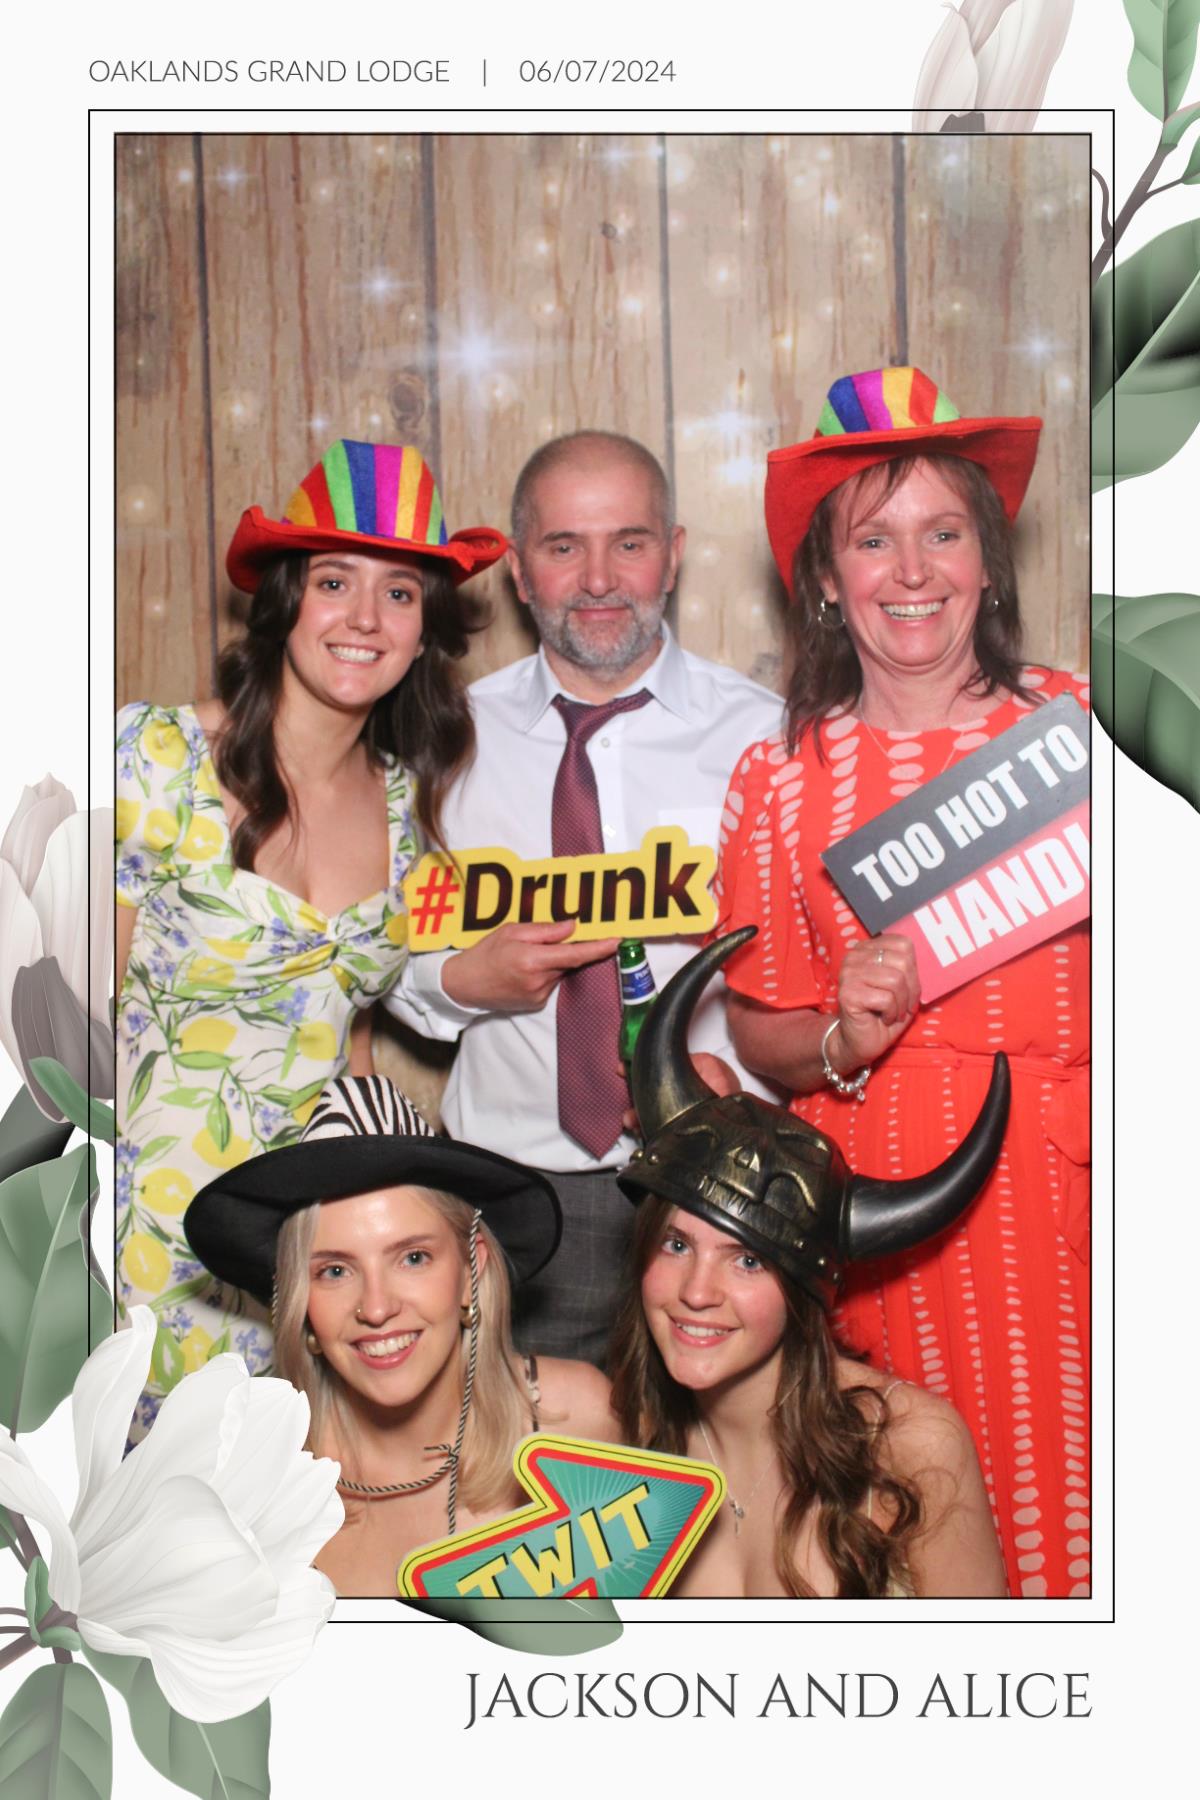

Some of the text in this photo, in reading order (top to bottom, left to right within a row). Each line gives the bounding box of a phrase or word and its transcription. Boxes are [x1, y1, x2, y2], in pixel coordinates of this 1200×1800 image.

[851, 724, 1088, 902] TOO HOT TO
[411, 841, 701, 936] #Drunk
[456, 1481, 652, 1598] TWIT
